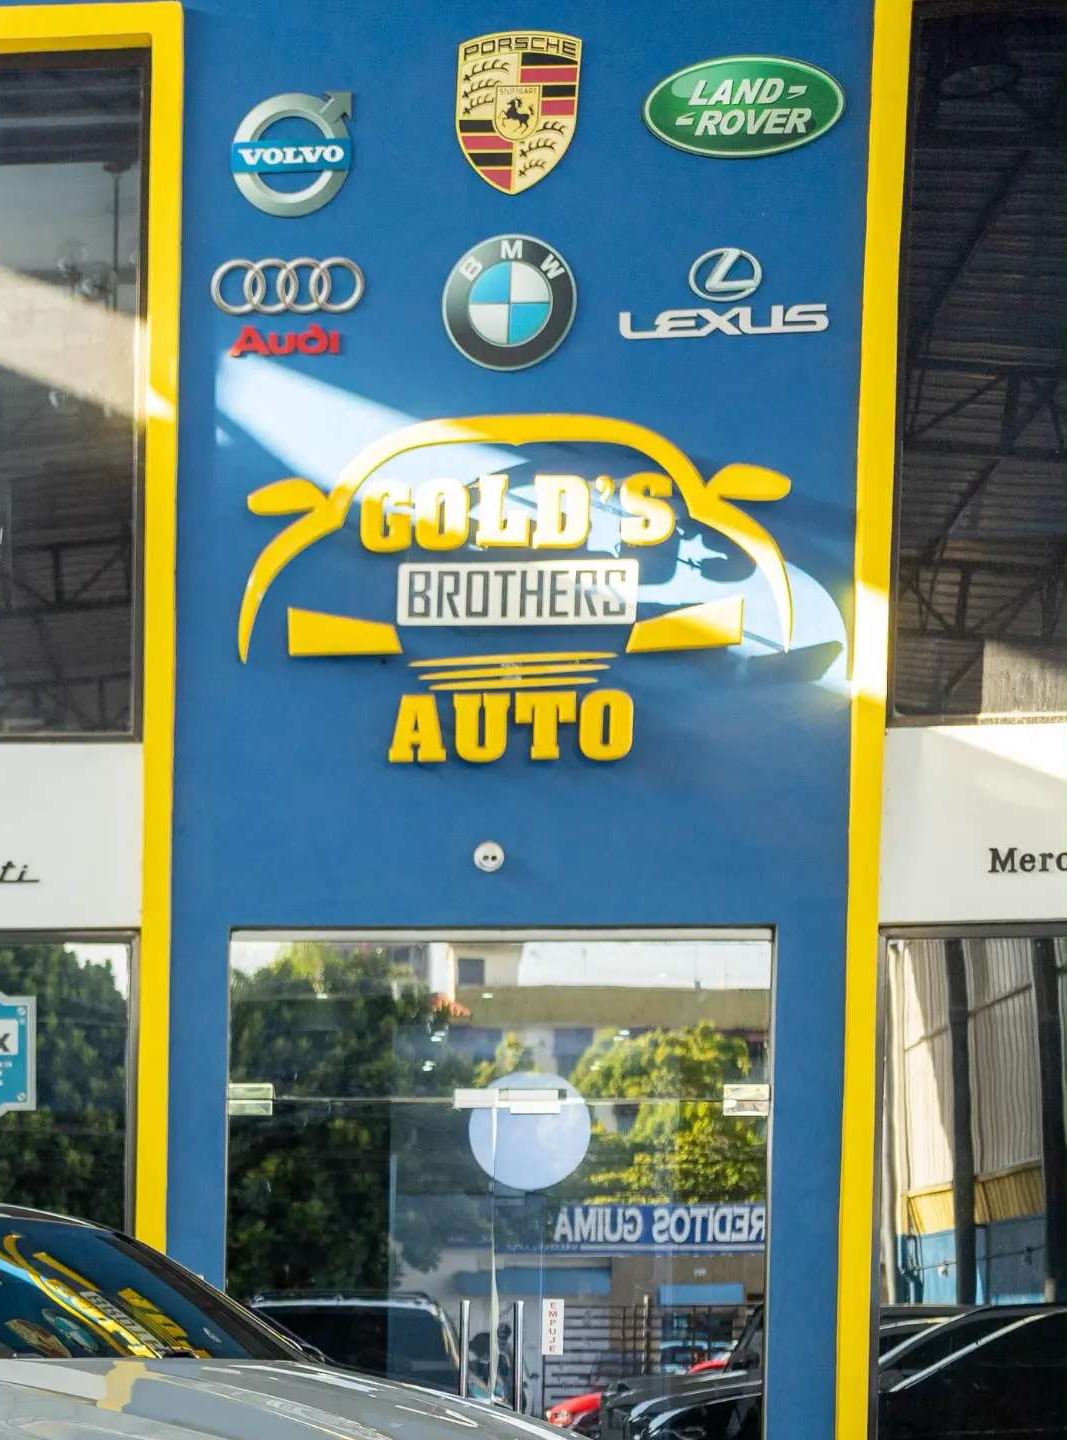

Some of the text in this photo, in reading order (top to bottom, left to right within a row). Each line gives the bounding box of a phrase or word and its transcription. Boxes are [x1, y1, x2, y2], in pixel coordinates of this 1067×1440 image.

[463, 36, 578, 61] PORSCHE
[687, 77, 785, 106] LAND
[693, 107, 813, 137] ROVER
[237, 144, 345, 166] VOLVO
[459, 239, 566, 281] BMW
[228, 322, 340, 357] Audi
[618, 303, 830, 340] LEXUS
[360, 472, 677, 554] GOLD'S
[407, 568, 628, 619] BROTHERS
[389, 690, 635, 763] AUTO
[547, 1301, 558, 1353] EMPUJE
